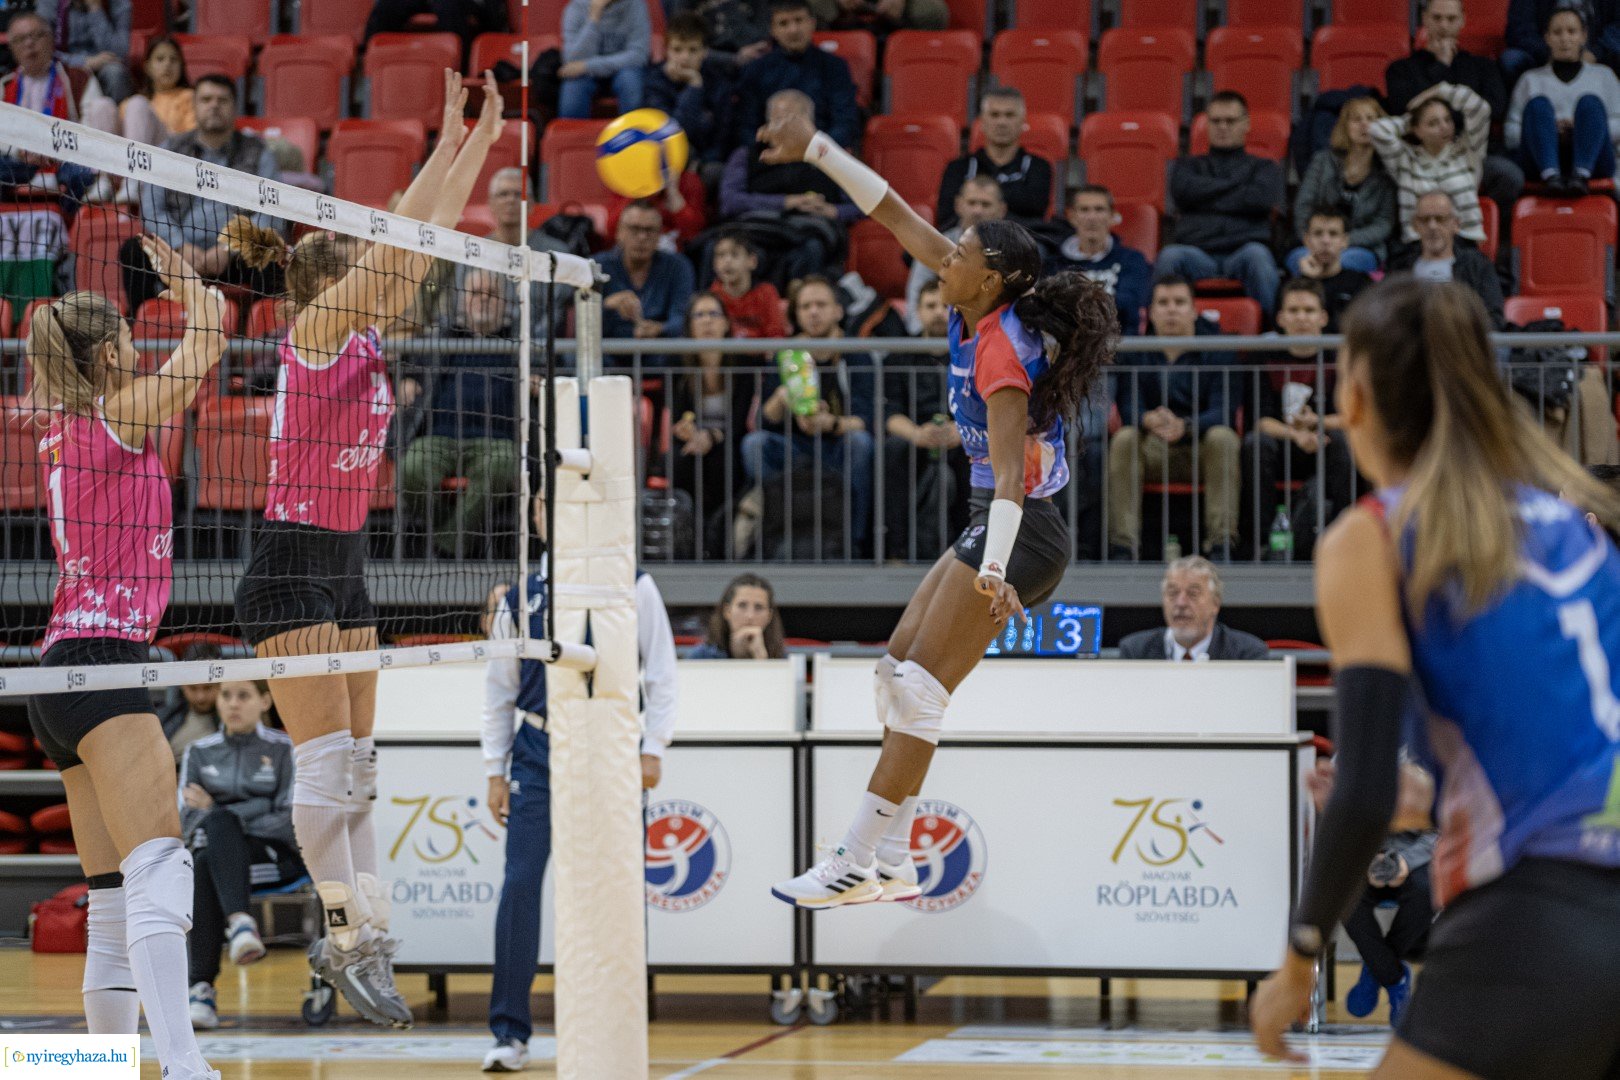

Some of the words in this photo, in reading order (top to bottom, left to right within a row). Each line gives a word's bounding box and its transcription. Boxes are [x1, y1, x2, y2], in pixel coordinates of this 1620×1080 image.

[62, 129, 78, 151] CEV
[137, 149, 152, 171] CEV
[205, 169, 219, 190] CEV
[267, 186, 280, 206] CEV
[1056, 618, 1082, 653] 3
[915, 801, 959, 819] ATUM
[1142, 870, 1192, 881] MAGYAR
[391, 878, 499, 904] ÖPLABD
[1096, 880, 1239, 908] RÖPLABDA
